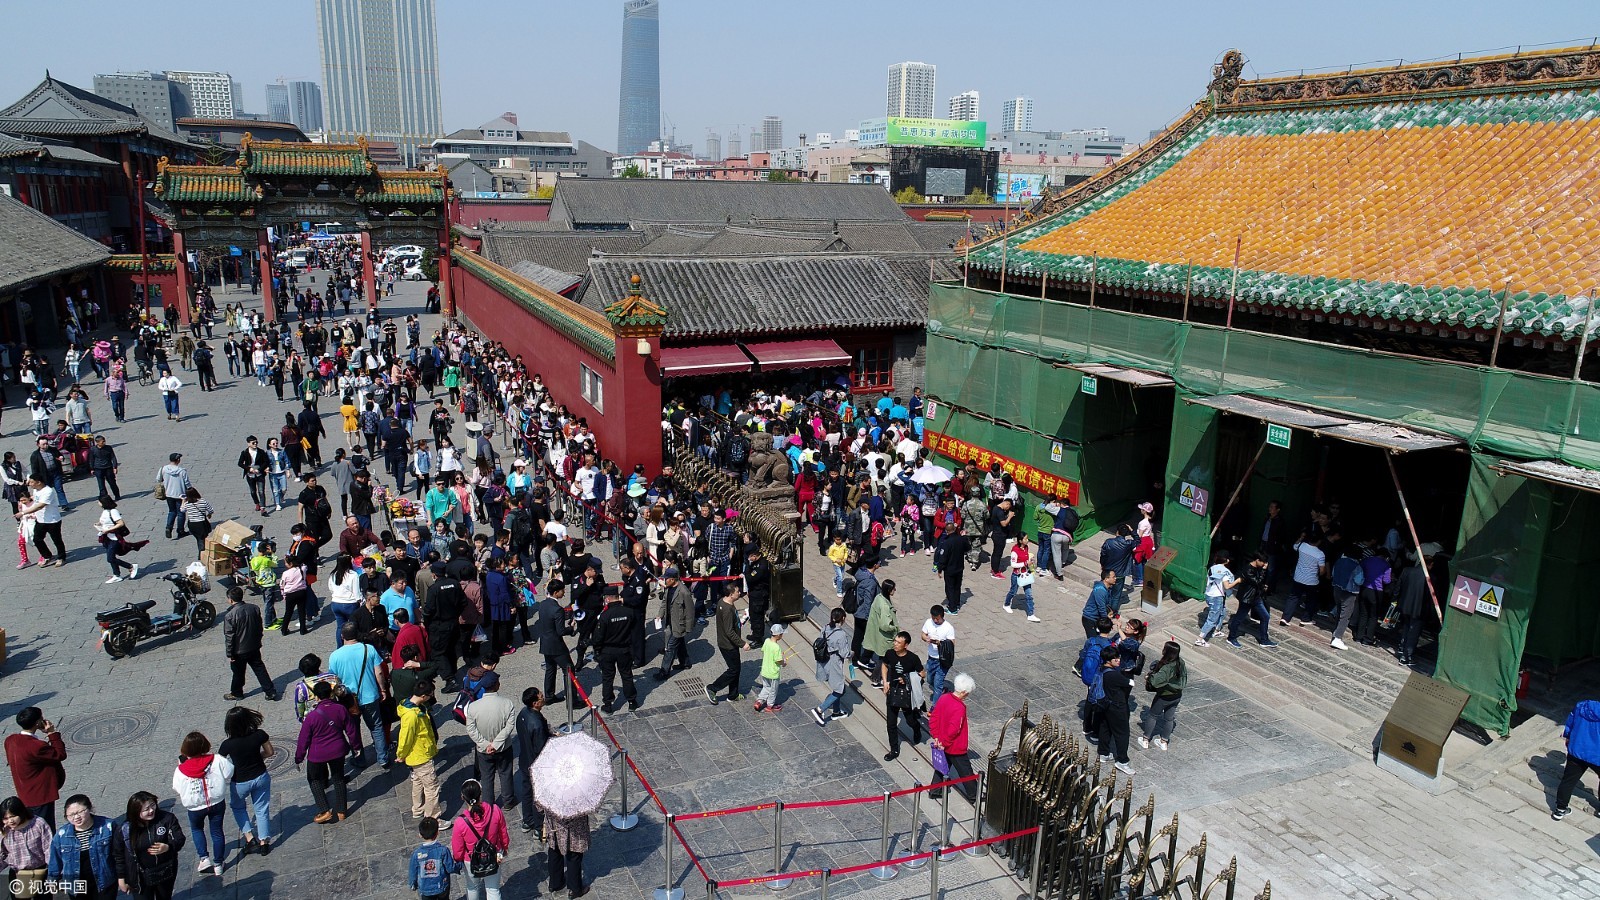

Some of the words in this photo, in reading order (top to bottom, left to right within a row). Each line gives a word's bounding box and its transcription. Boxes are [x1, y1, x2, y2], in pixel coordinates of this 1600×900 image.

[900, 126, 937, 138] 普惠万家
[1195, 491, 1205, 512] 入口
[1456, 580, 1473, 609] 入口
